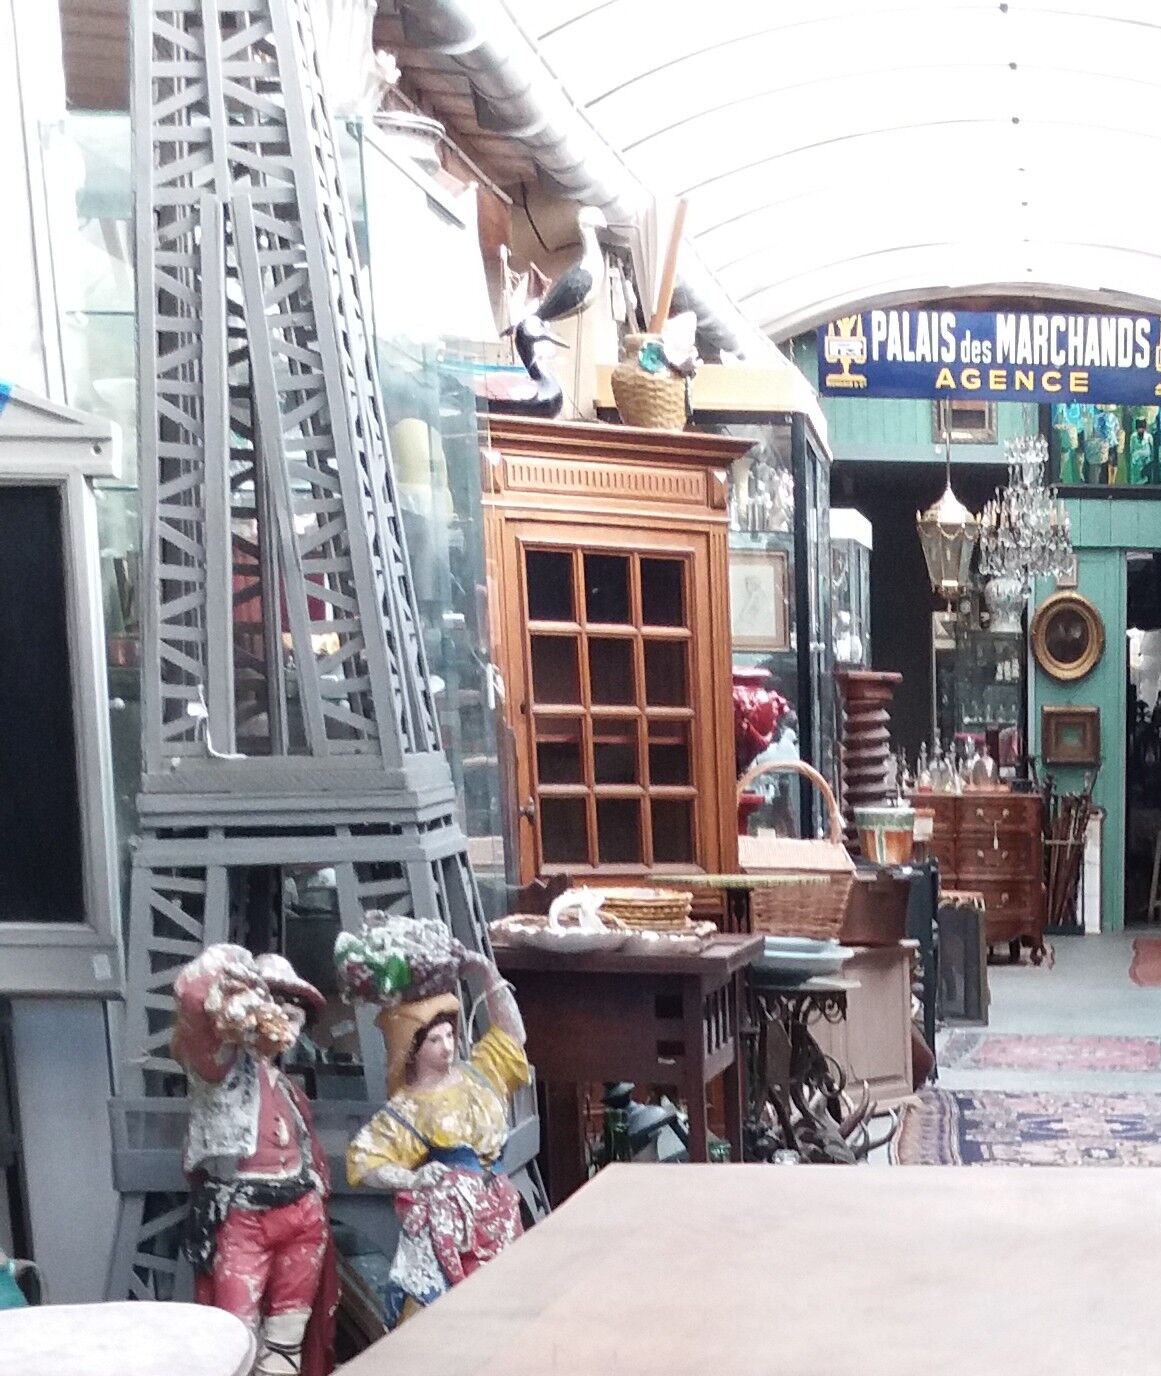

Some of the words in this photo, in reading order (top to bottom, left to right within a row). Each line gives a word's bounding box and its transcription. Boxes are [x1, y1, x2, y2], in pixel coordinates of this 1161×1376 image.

[872, 310, 956, 362] PALAIS
[961, 329, 992, 363] des
[996, 313, 1151, 368] MARCHANDS
[935, 367, 1089, 393] AGENCE
